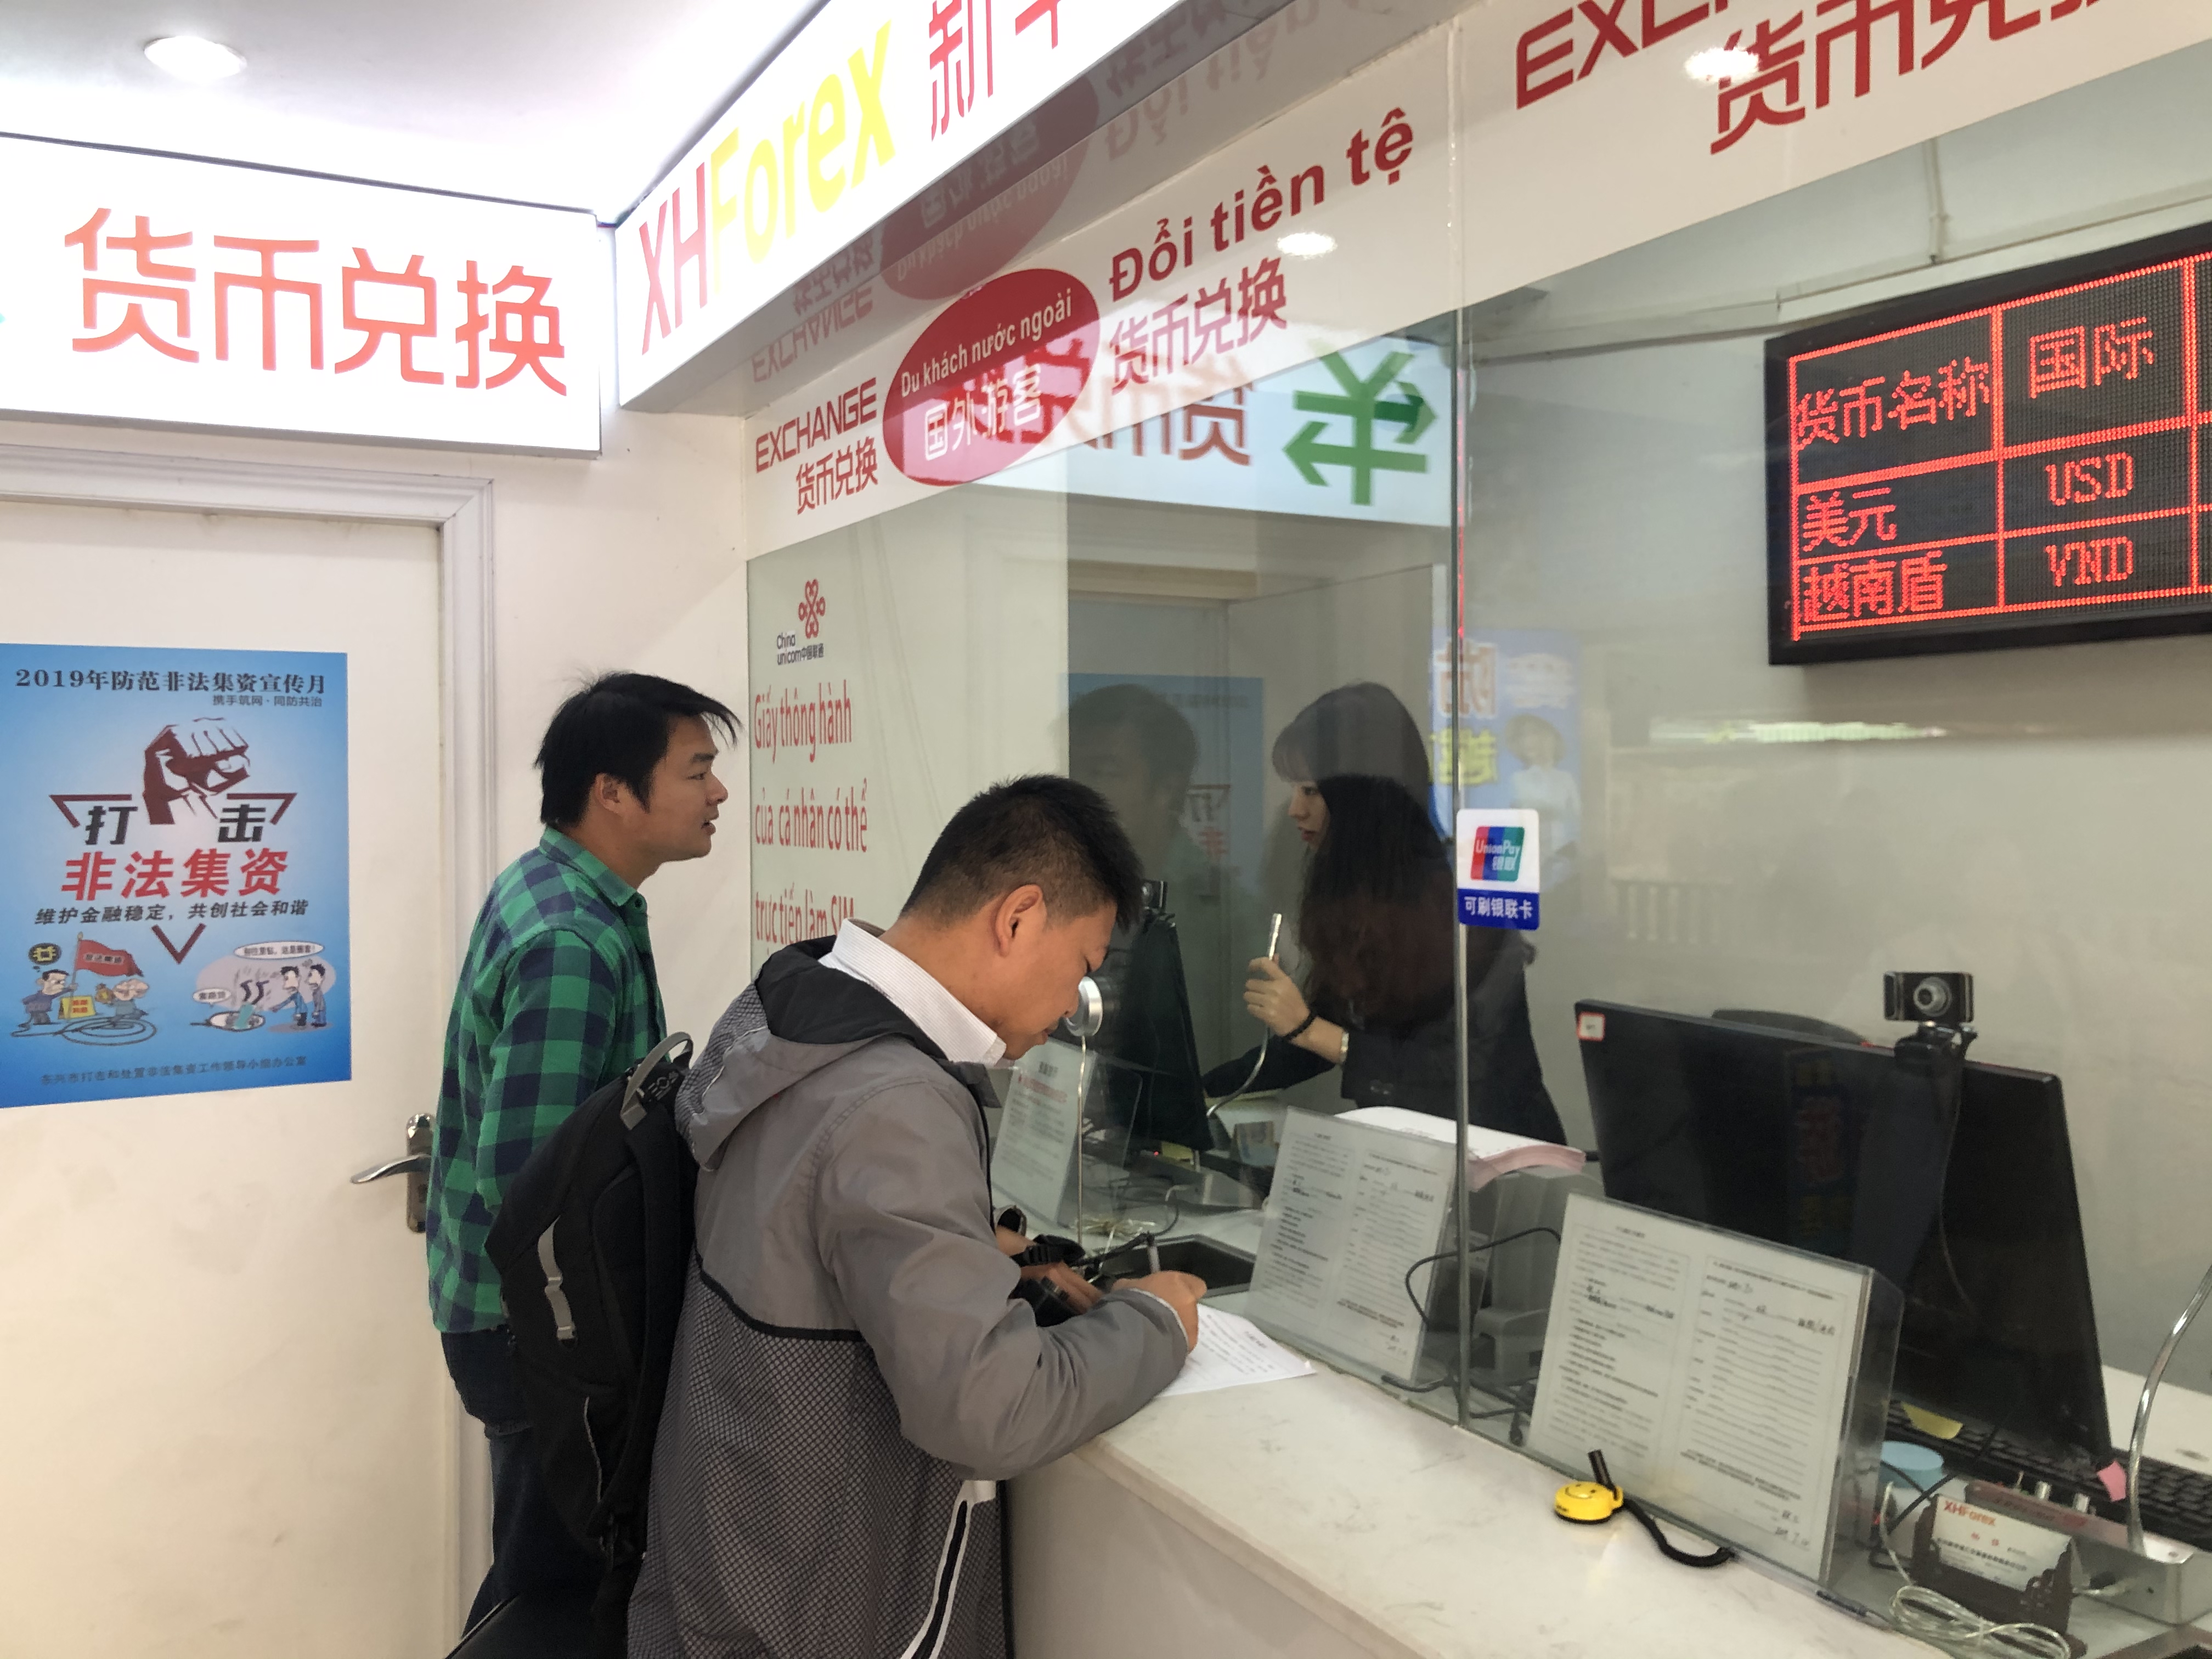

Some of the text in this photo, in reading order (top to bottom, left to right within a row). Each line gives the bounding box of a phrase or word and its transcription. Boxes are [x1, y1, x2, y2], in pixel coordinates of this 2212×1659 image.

[639, 18, 896, 355] XHForex
[1109, 216, 1193, 302] Đổi
[1211, 165, 1325, 252] tiền
[1346, 107, 1413, 186] tệ
[64, 207, 567, 397] 货币兑换
[901, 288, 1071, 397] Du khách nước ngoài
[1110, 256, 1286, 395] 货币兑换
[755, 377, 877, 473] EXCHANGE
[924, 363, 1041, 461] 国外游客
[1795, 316, 2153, 450] 货币名称 国际
[796, 436, 878, 515] 货币兑换
[1803, 452, 2134, 551] 美元 USD
[1803, 536, 2134, 622] 越南盾 VND
[15, 669, 325, 695] 2019年防范非法集资宣传月
[777, 632, 795, 649] China
[755, 679, 851, 764] Giấy thông hành
[755, 787, 774, 844] của
[828, 787, 842, 850] có
[1475, 839, 1520, 860] UnionPay
[61, 848, 287, 901] 非法集资
[805, 889, 827, 940] làm
[1464, 896, 1533, 919] 可刷银联卡
